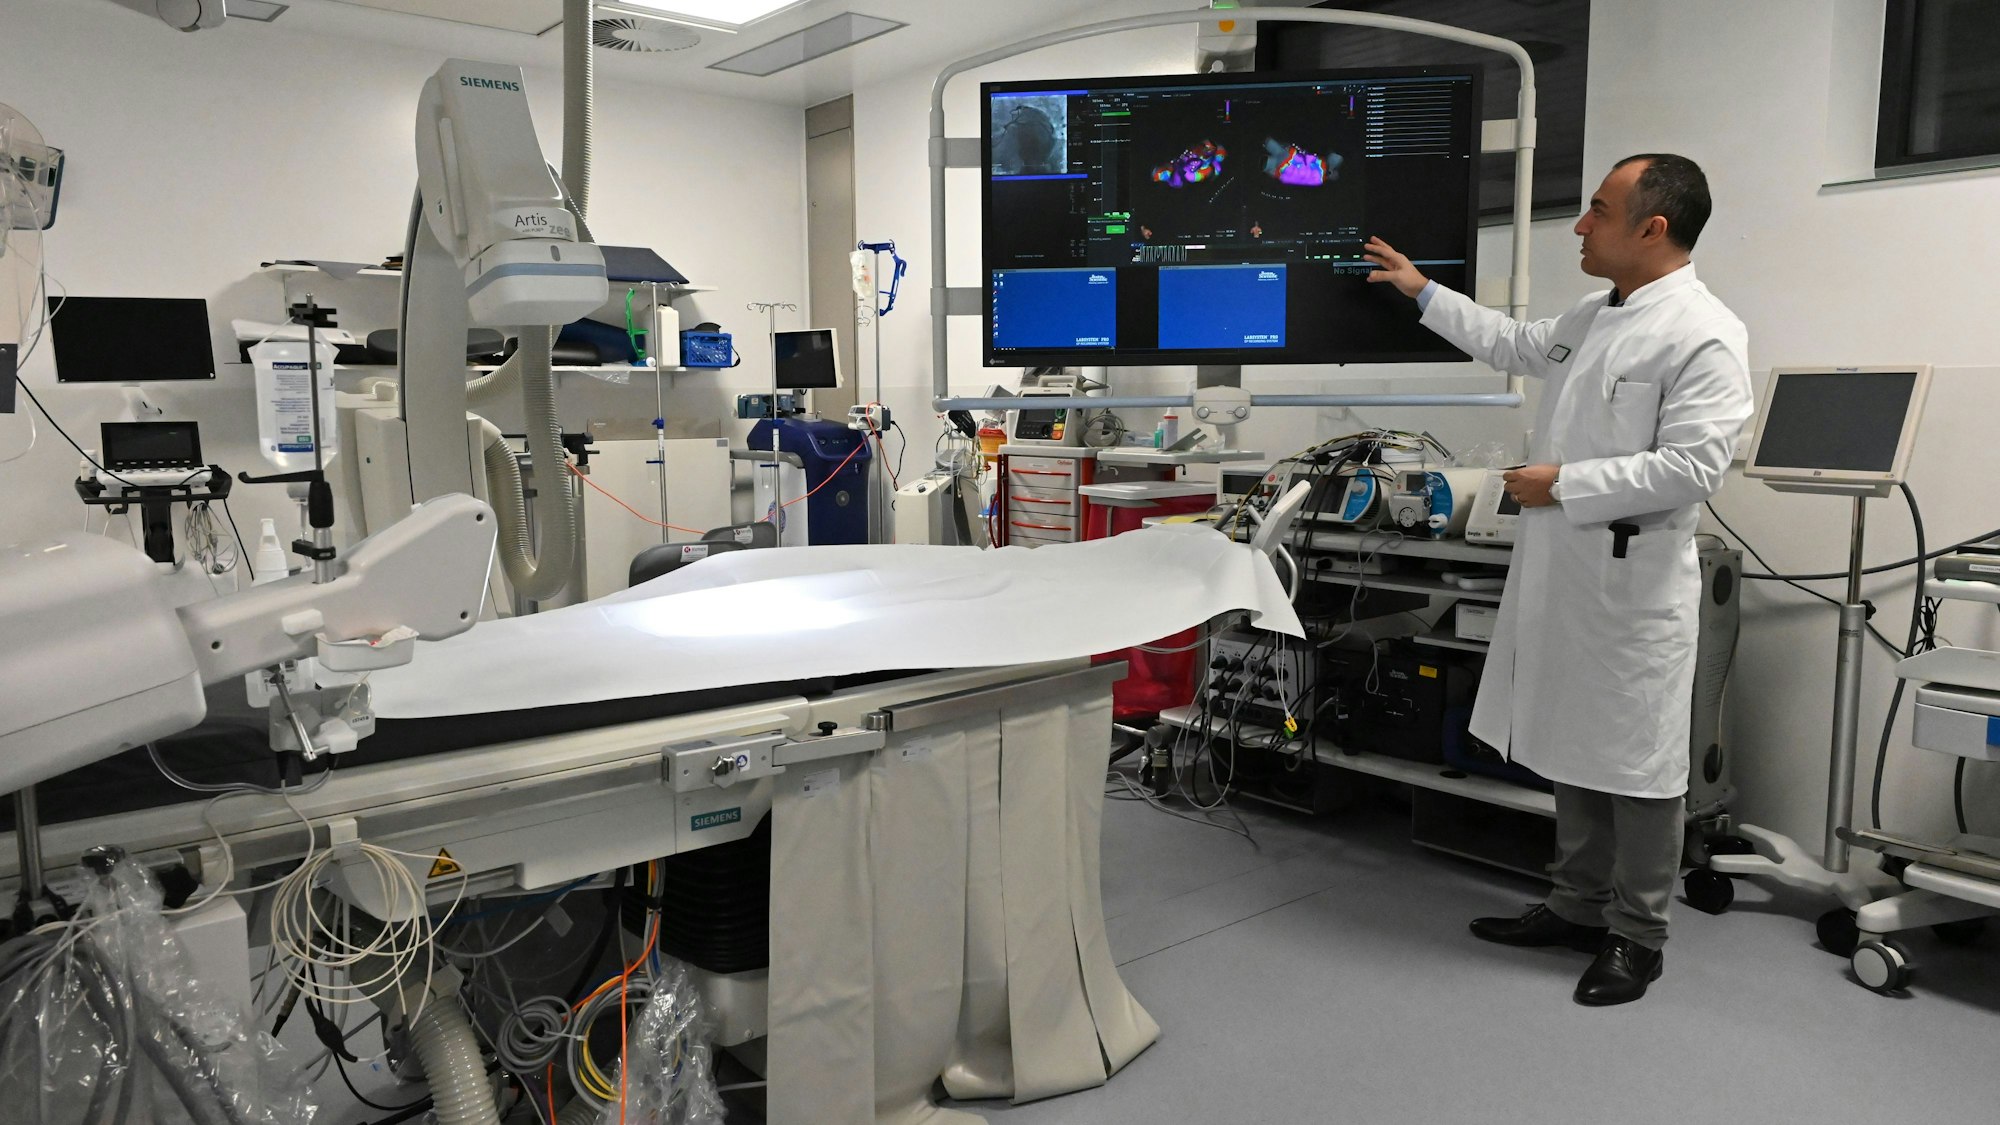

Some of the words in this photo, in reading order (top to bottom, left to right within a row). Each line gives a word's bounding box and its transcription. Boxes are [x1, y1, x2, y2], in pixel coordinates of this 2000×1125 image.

[460, 76, 520, 92] SIEMENS
[515, 212, 548, 227] Artis
[549, 225, 571, 237] zee
[1333, 267, 1345, 275] No
[1347, 266, 1373, 275] Signal
[694, 810, 738, 828] SIEMENS
